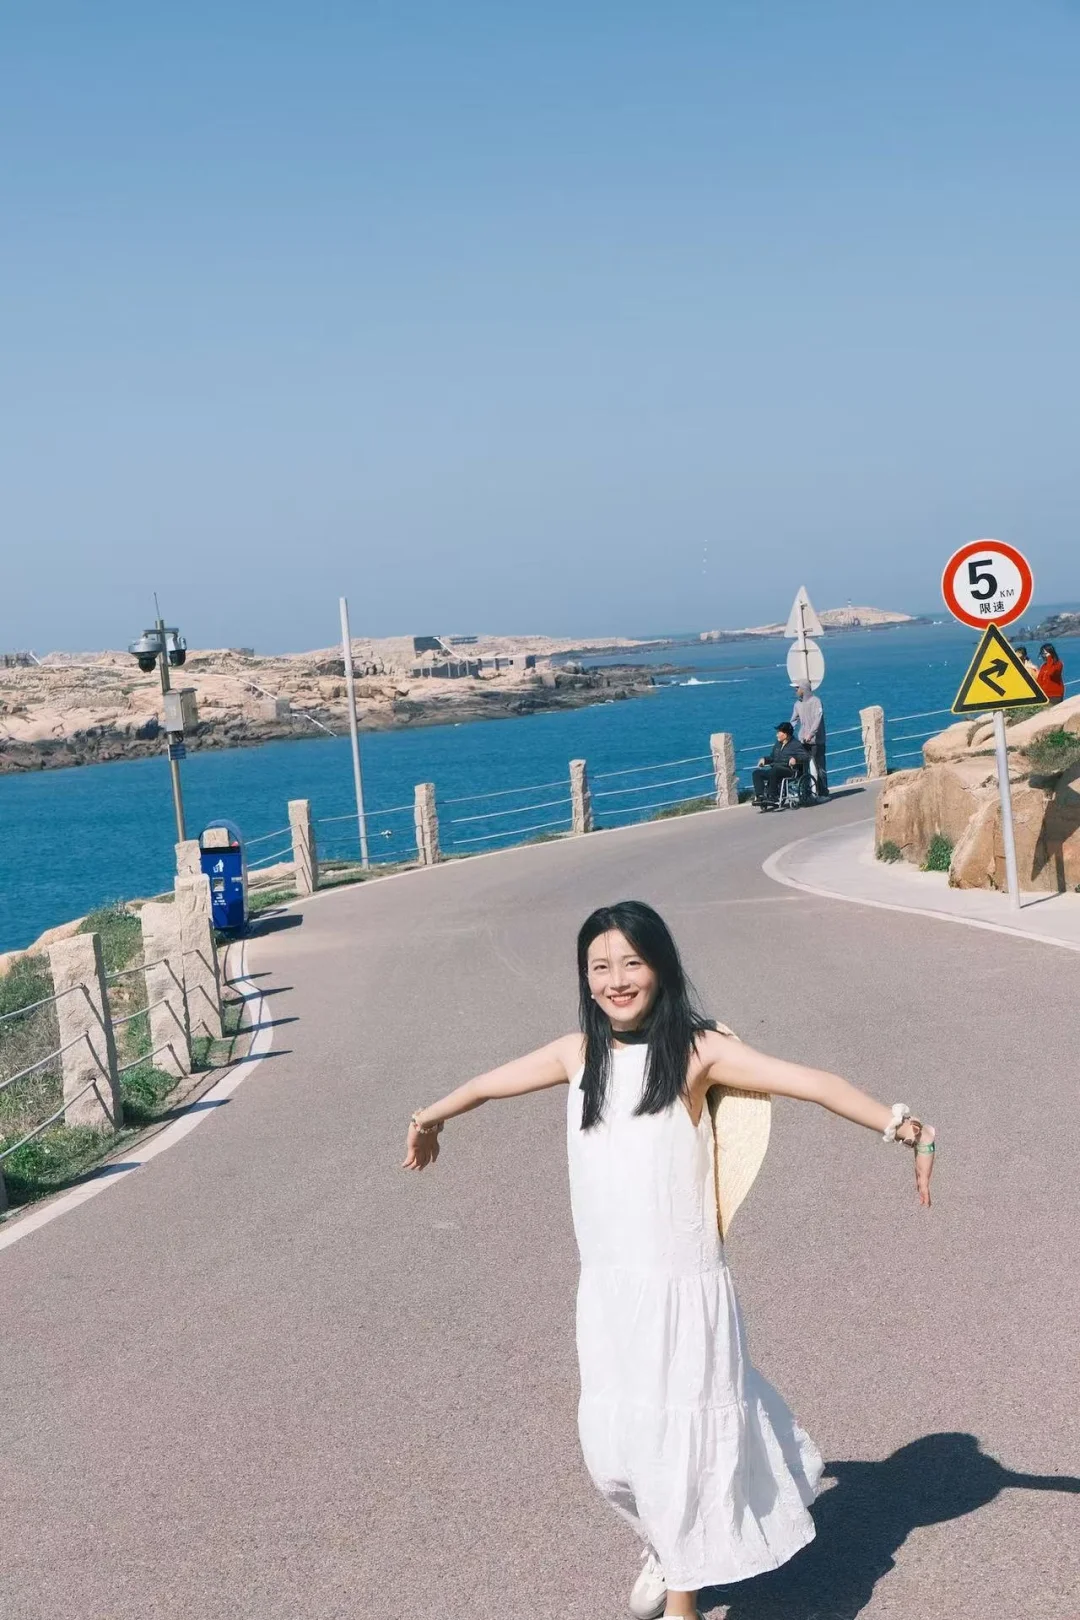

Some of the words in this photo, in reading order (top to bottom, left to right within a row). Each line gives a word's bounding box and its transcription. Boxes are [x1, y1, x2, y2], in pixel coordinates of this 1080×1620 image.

[968, 559, 998, 600] 5
[1000, 589, 1014, 598] KM
[979, 600, 1005, 614] 限速
